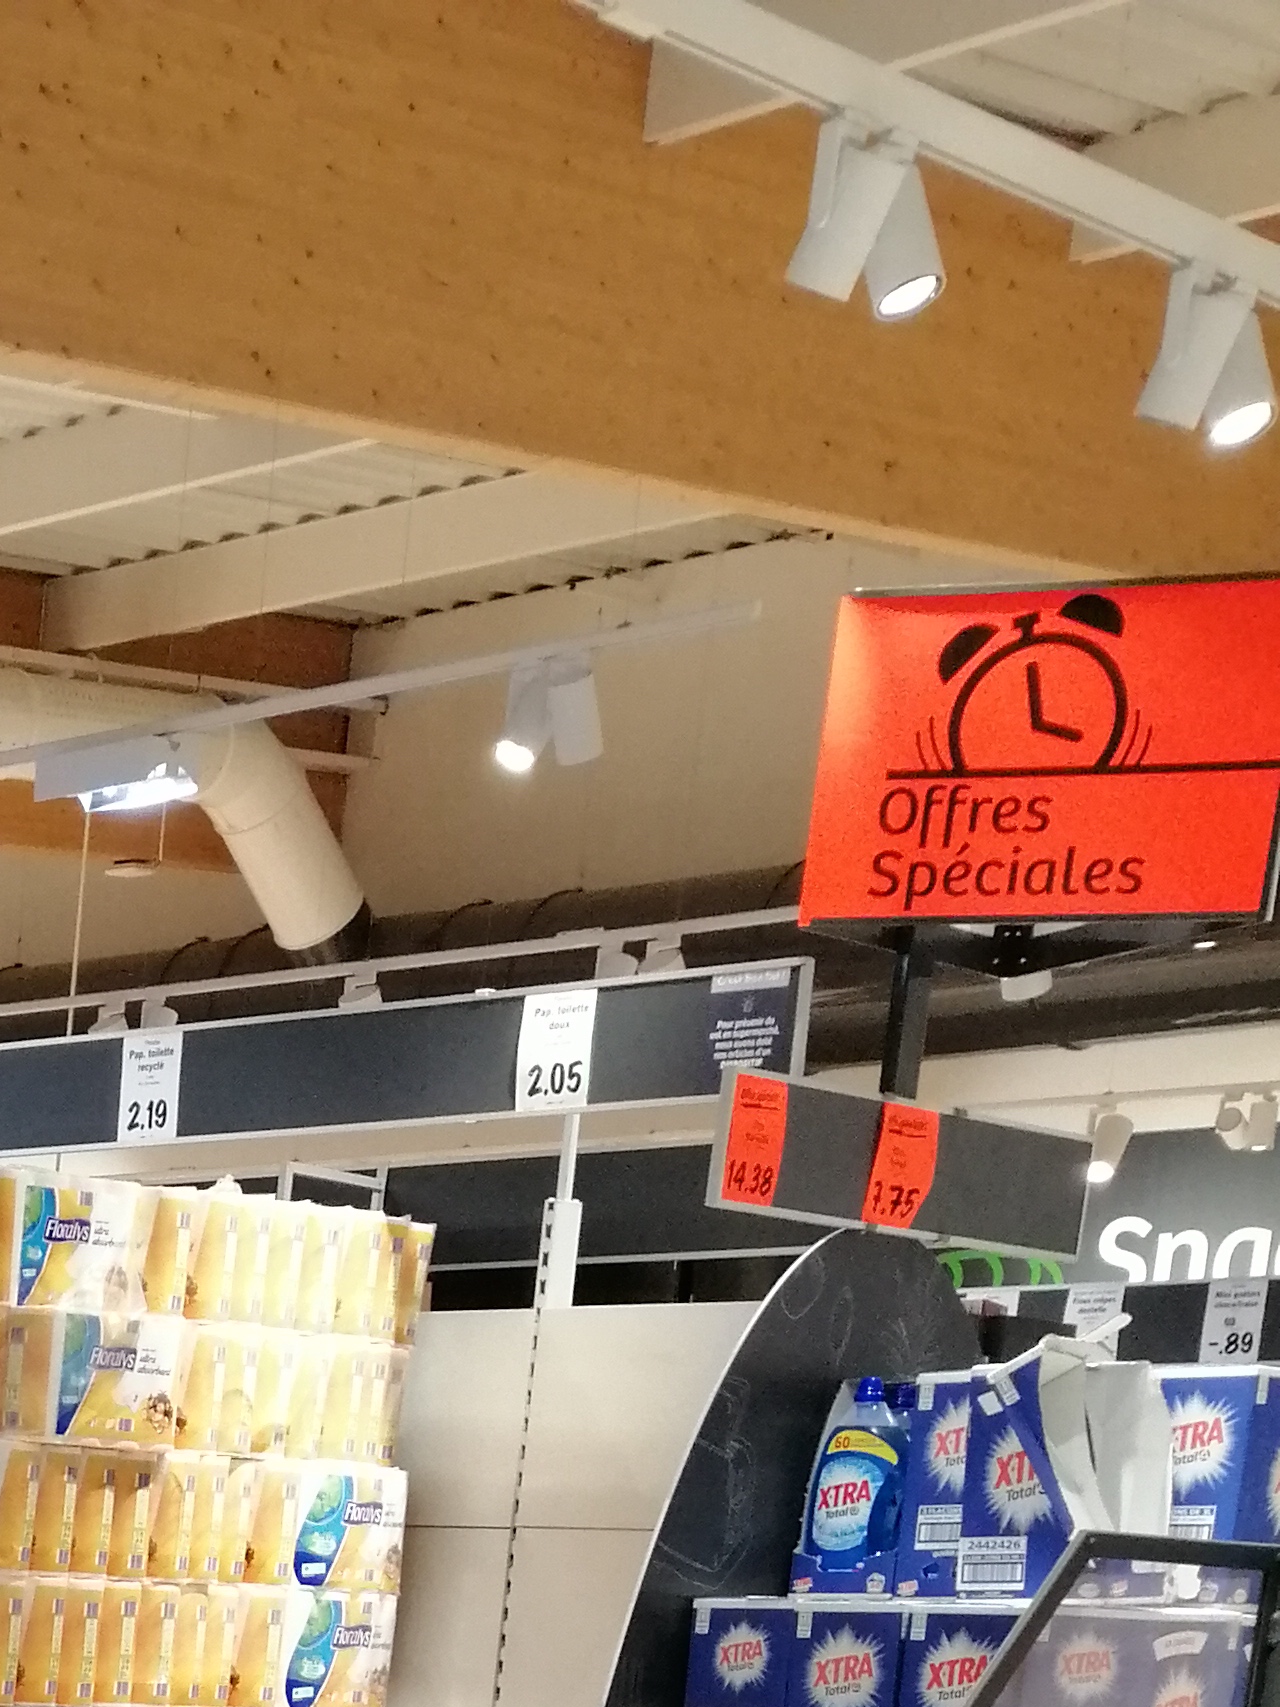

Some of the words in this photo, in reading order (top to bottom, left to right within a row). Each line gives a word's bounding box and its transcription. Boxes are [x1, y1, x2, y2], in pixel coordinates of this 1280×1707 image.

[880, 784, 1053, 849] Offres
[869, 845, 1146, 911] Spéciales
[534, 1006, 553, 1018] Pap.
[557, 1002, 589, 1015] toilette
[548, 1020, 570, 1031] doux
[528, 1061, 583, 1098] 2.05
[127, 1099, 167, 1131] 2.19
[728, 1159, 774, 1197] 14.38
[45, 1217, 90, 1243] Floralys
[1099, 1215, 1280, 1283] Sna
[834, 1437, 850, 1449] 60
[825, 1508, 849, 1519] Total
[967, 1539, 1021, 1551] 2442426
[825, 1683, 850, 1696] Total
[937, 1686, 965, 1701] Total
